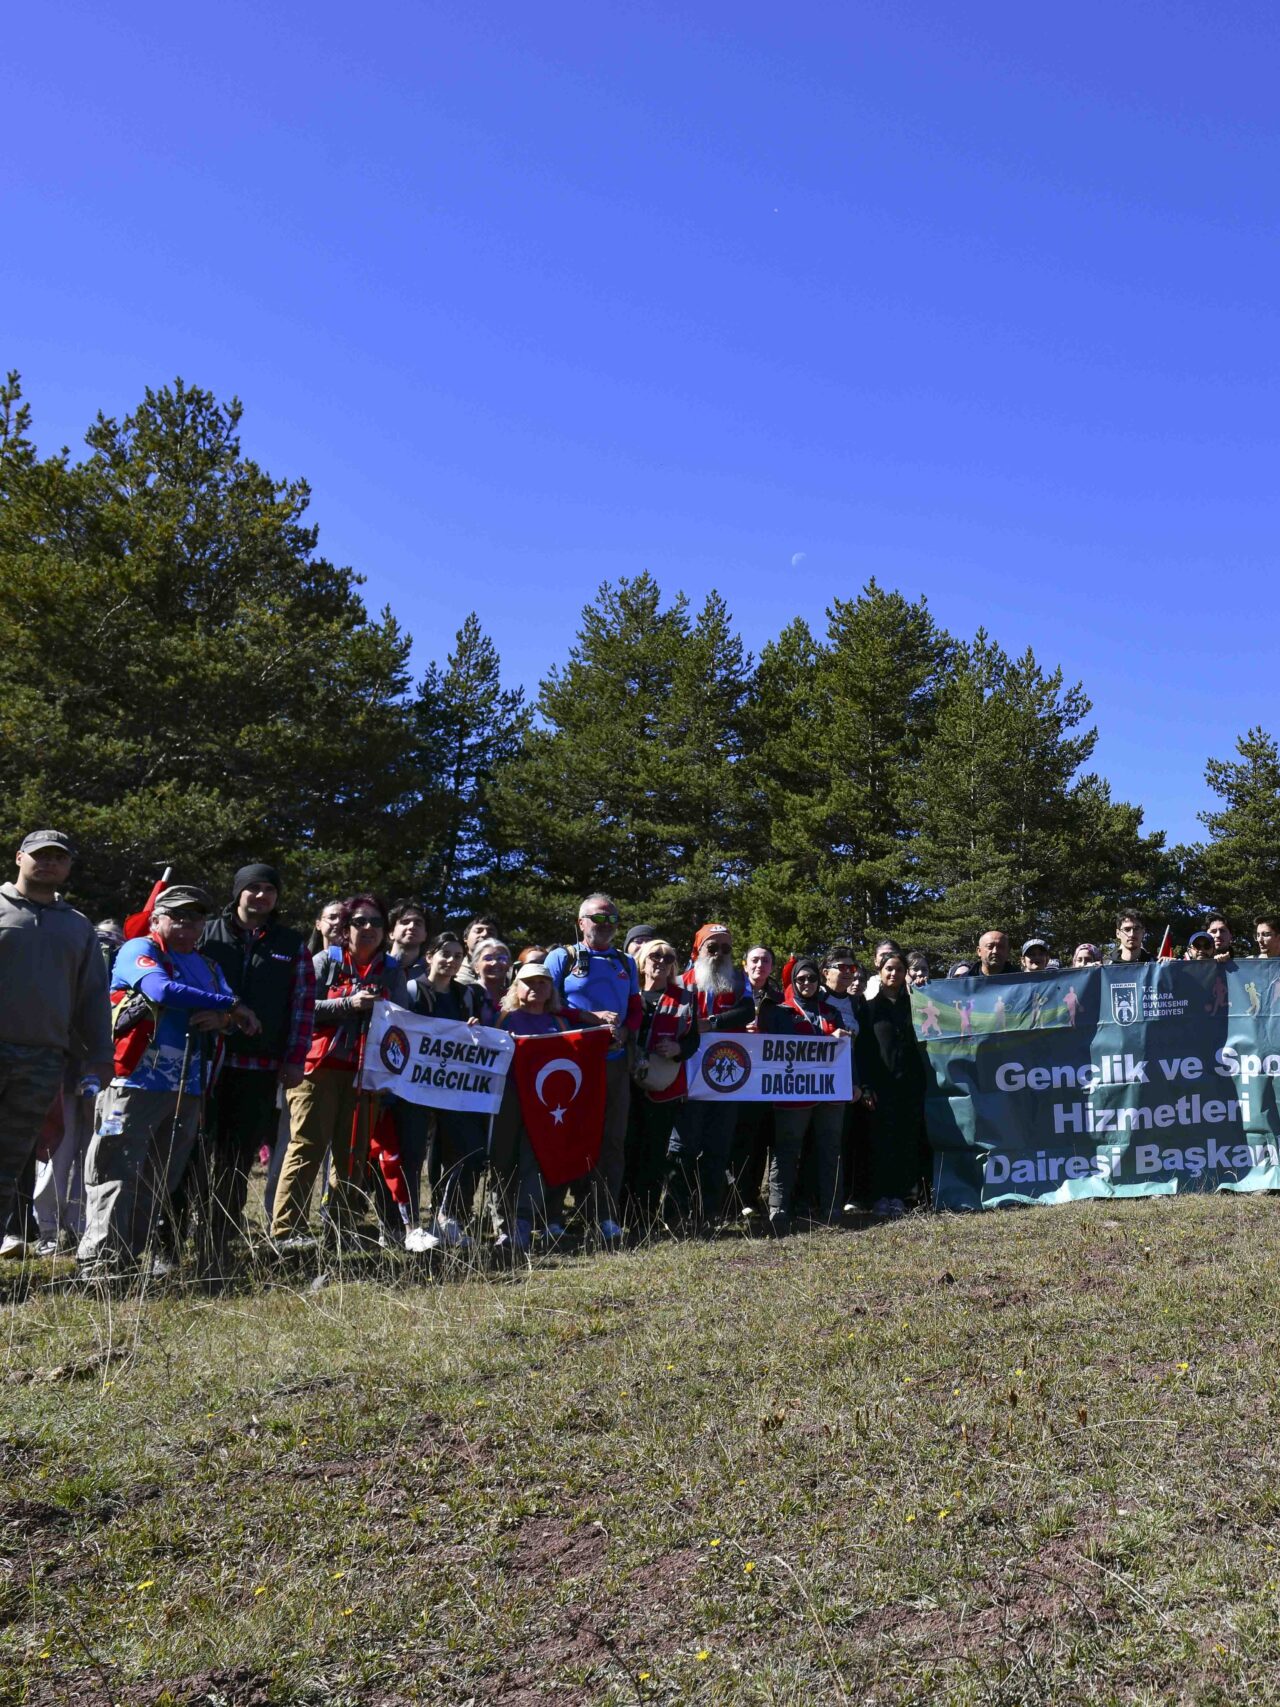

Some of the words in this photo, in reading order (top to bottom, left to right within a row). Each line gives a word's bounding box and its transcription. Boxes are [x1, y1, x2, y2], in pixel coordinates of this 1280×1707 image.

[1143, 993, 1174, 1001] ANKARA
[418, 1036, 500, 1068] BAŞKENT
[762, 1040, 839, 1069] BAŞKENT
[411, 1062, 492, 1094] DAĞCILIK
[761, 1068, 836, 1095] DAĞCILIK
[995, 1053, 1150, 1094] Gençlik
[1159, 1056, 1203, 1081] ve
[1053, 1092, 1251, 1134] Hizmetleri
[985, 1147, 1122, 1184] Dairesi
